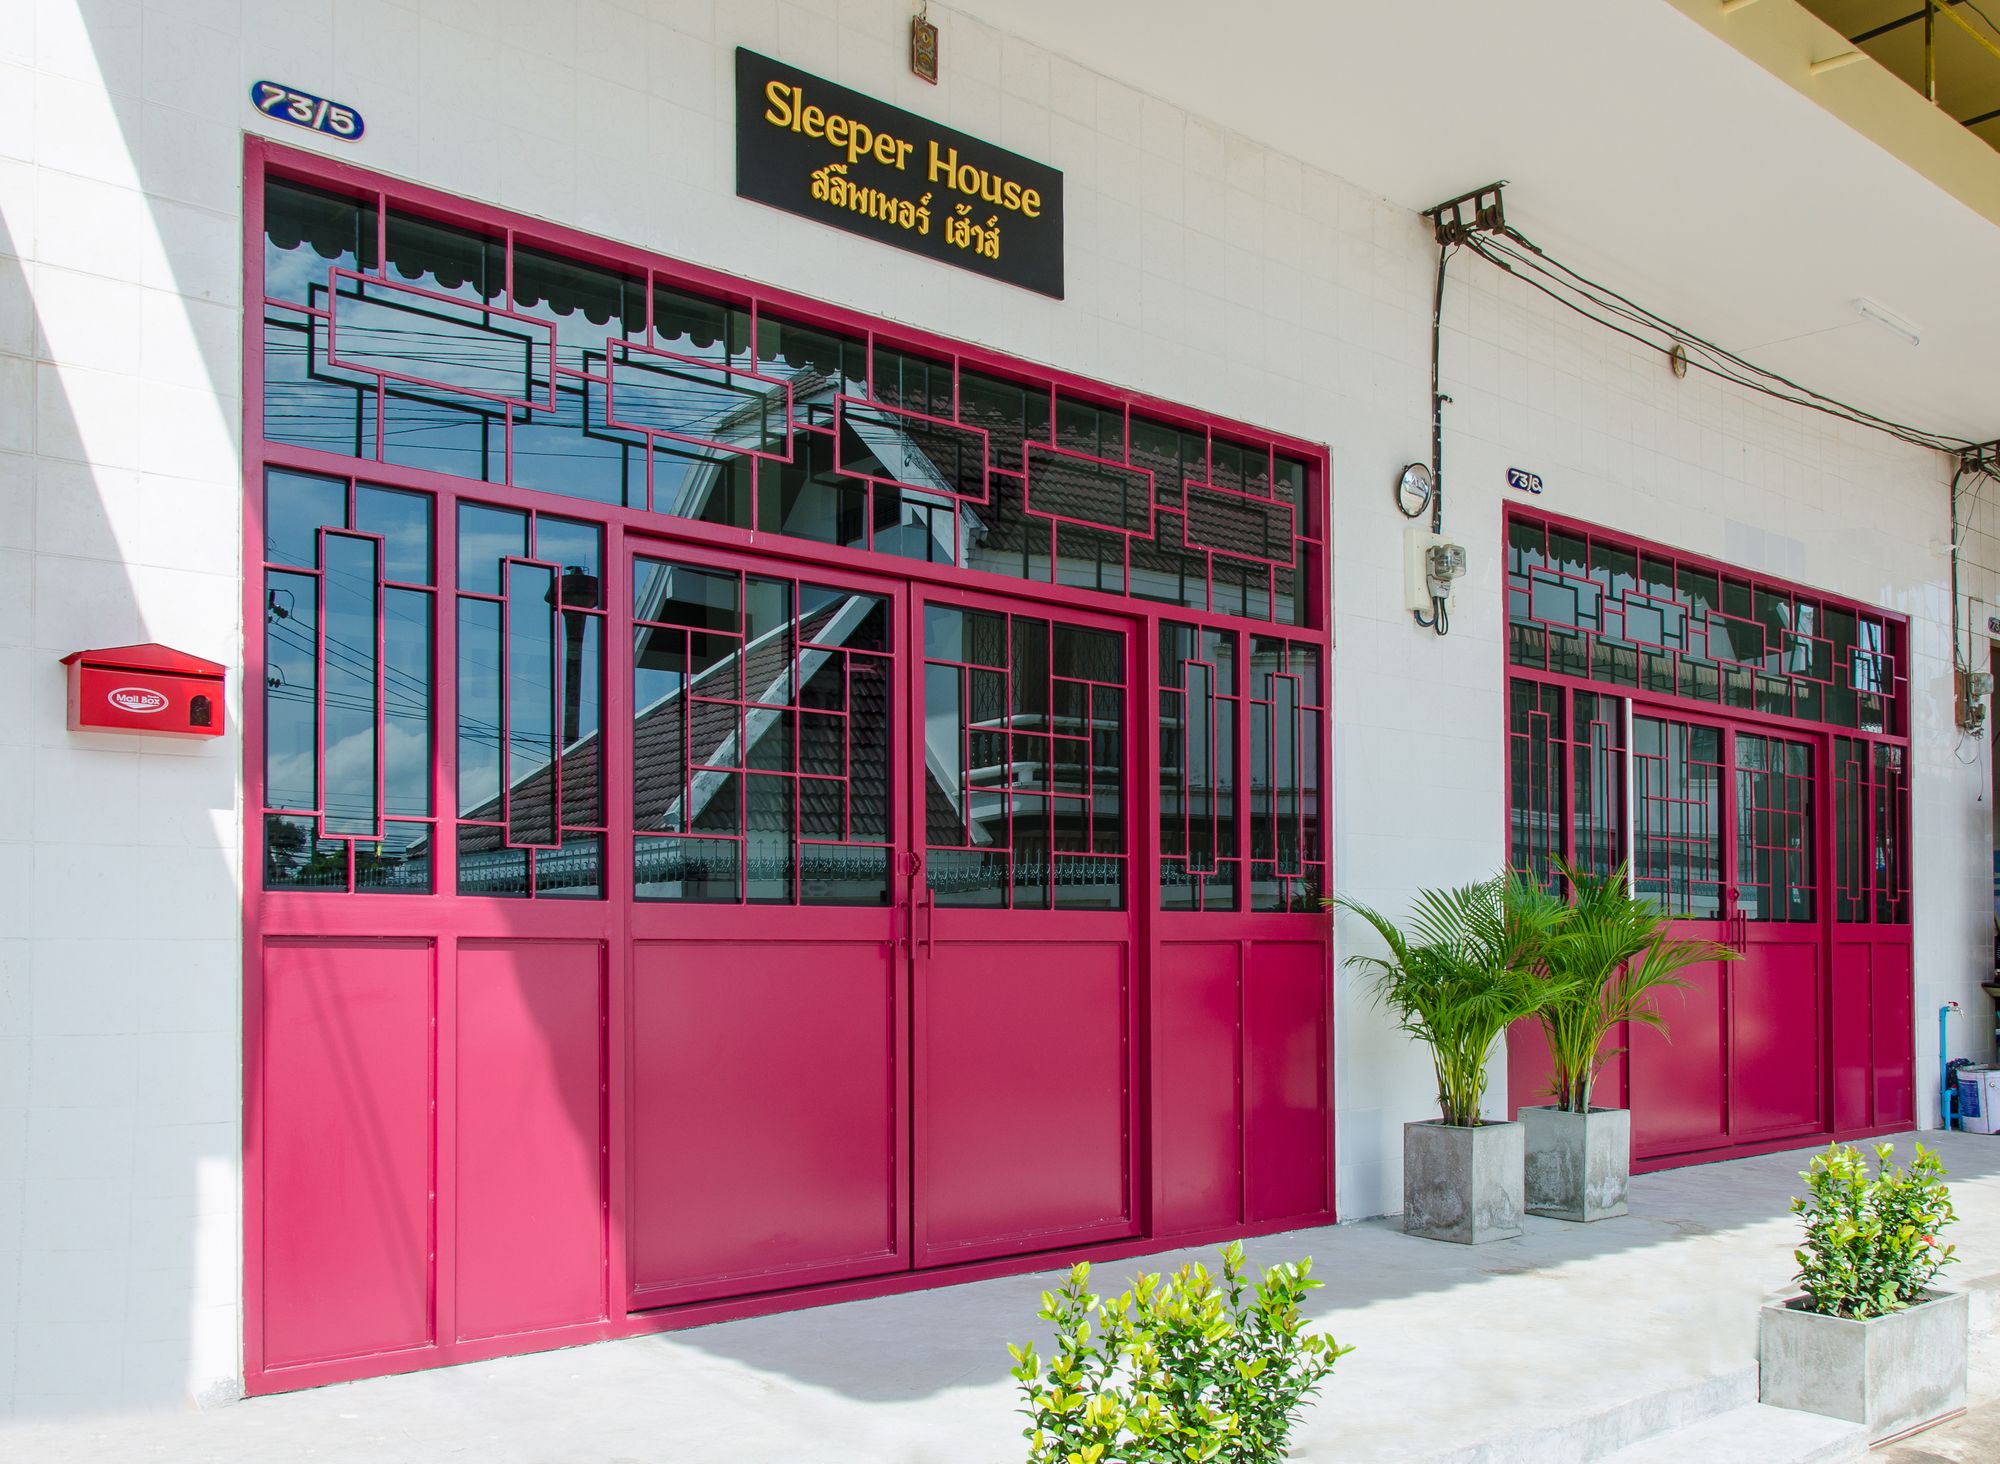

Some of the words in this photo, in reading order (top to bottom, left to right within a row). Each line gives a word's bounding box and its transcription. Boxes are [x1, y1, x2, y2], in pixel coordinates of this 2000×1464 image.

[260, 84, 356, 135] 73/5
[764, 80, 913, 170] Sleeper
[927, 140, 1041, 218] House
[944, 203, 1000, 260] เฮ้าส์
[1511, 470, 1542, 492] 73/6
[116, 693, 139, 703] Mail
[141, 695, 160, 705] Box
